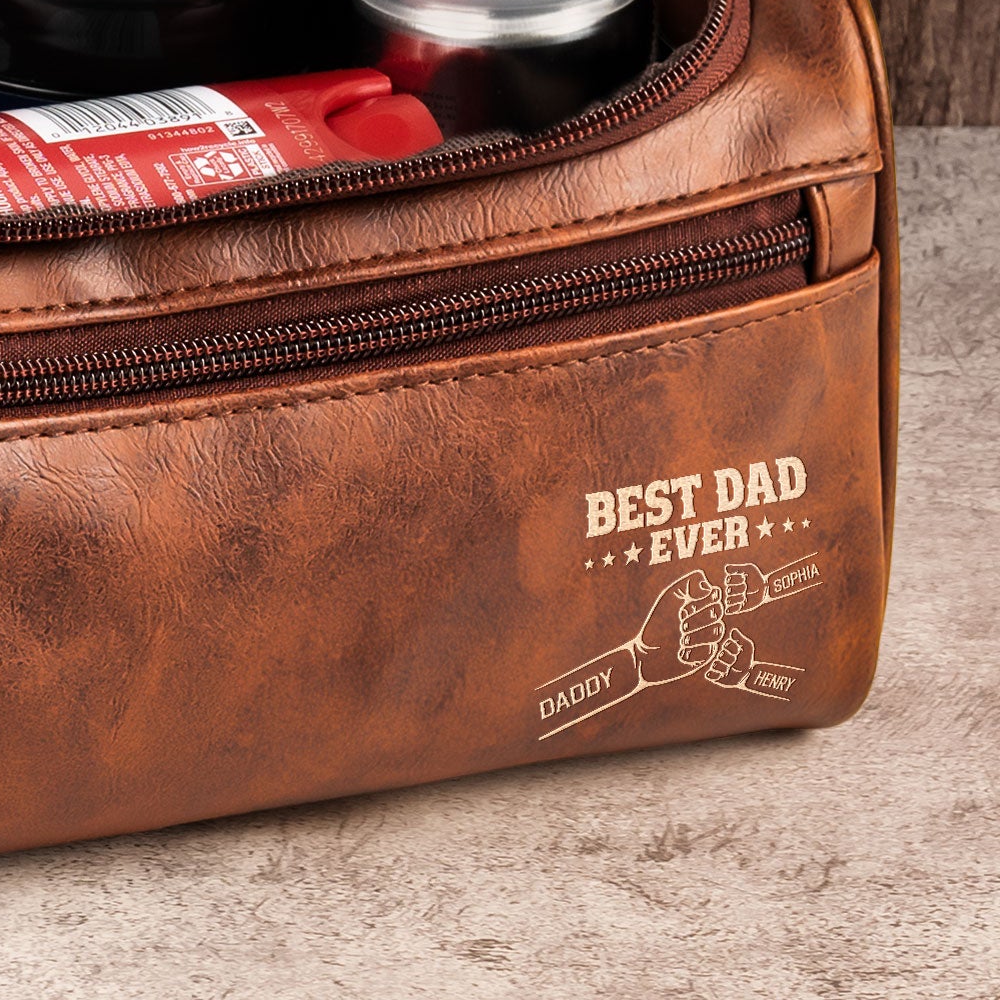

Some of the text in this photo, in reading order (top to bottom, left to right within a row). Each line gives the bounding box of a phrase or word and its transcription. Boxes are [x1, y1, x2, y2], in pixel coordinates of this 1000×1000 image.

[81, 118, 140, 134] 12044
[144, 111, 202, 126] 03891
[148, 126, 215, 140] 91344802
[22, 141, 37, 149] AS
[28, 149, 48, 163] ONLY
[17, 153, 43, 177] BROKEN
[40, 162, 57, 175] USE
[238, 147, 263, 176] PLASTIC
[35, 177, 48, 186] TO
[124, 169, 156, 211] ETRASODIUM
[102, 182, 125, 206] SODIUM
[585, 456, 807, 538] BEST DAD
[648, 515, 749, 566] EVER
[773, 563, 820, 593] SOPHIA
[753, 670, 796, 692] HENRY
[539, 667, 614, 720] DADDY
